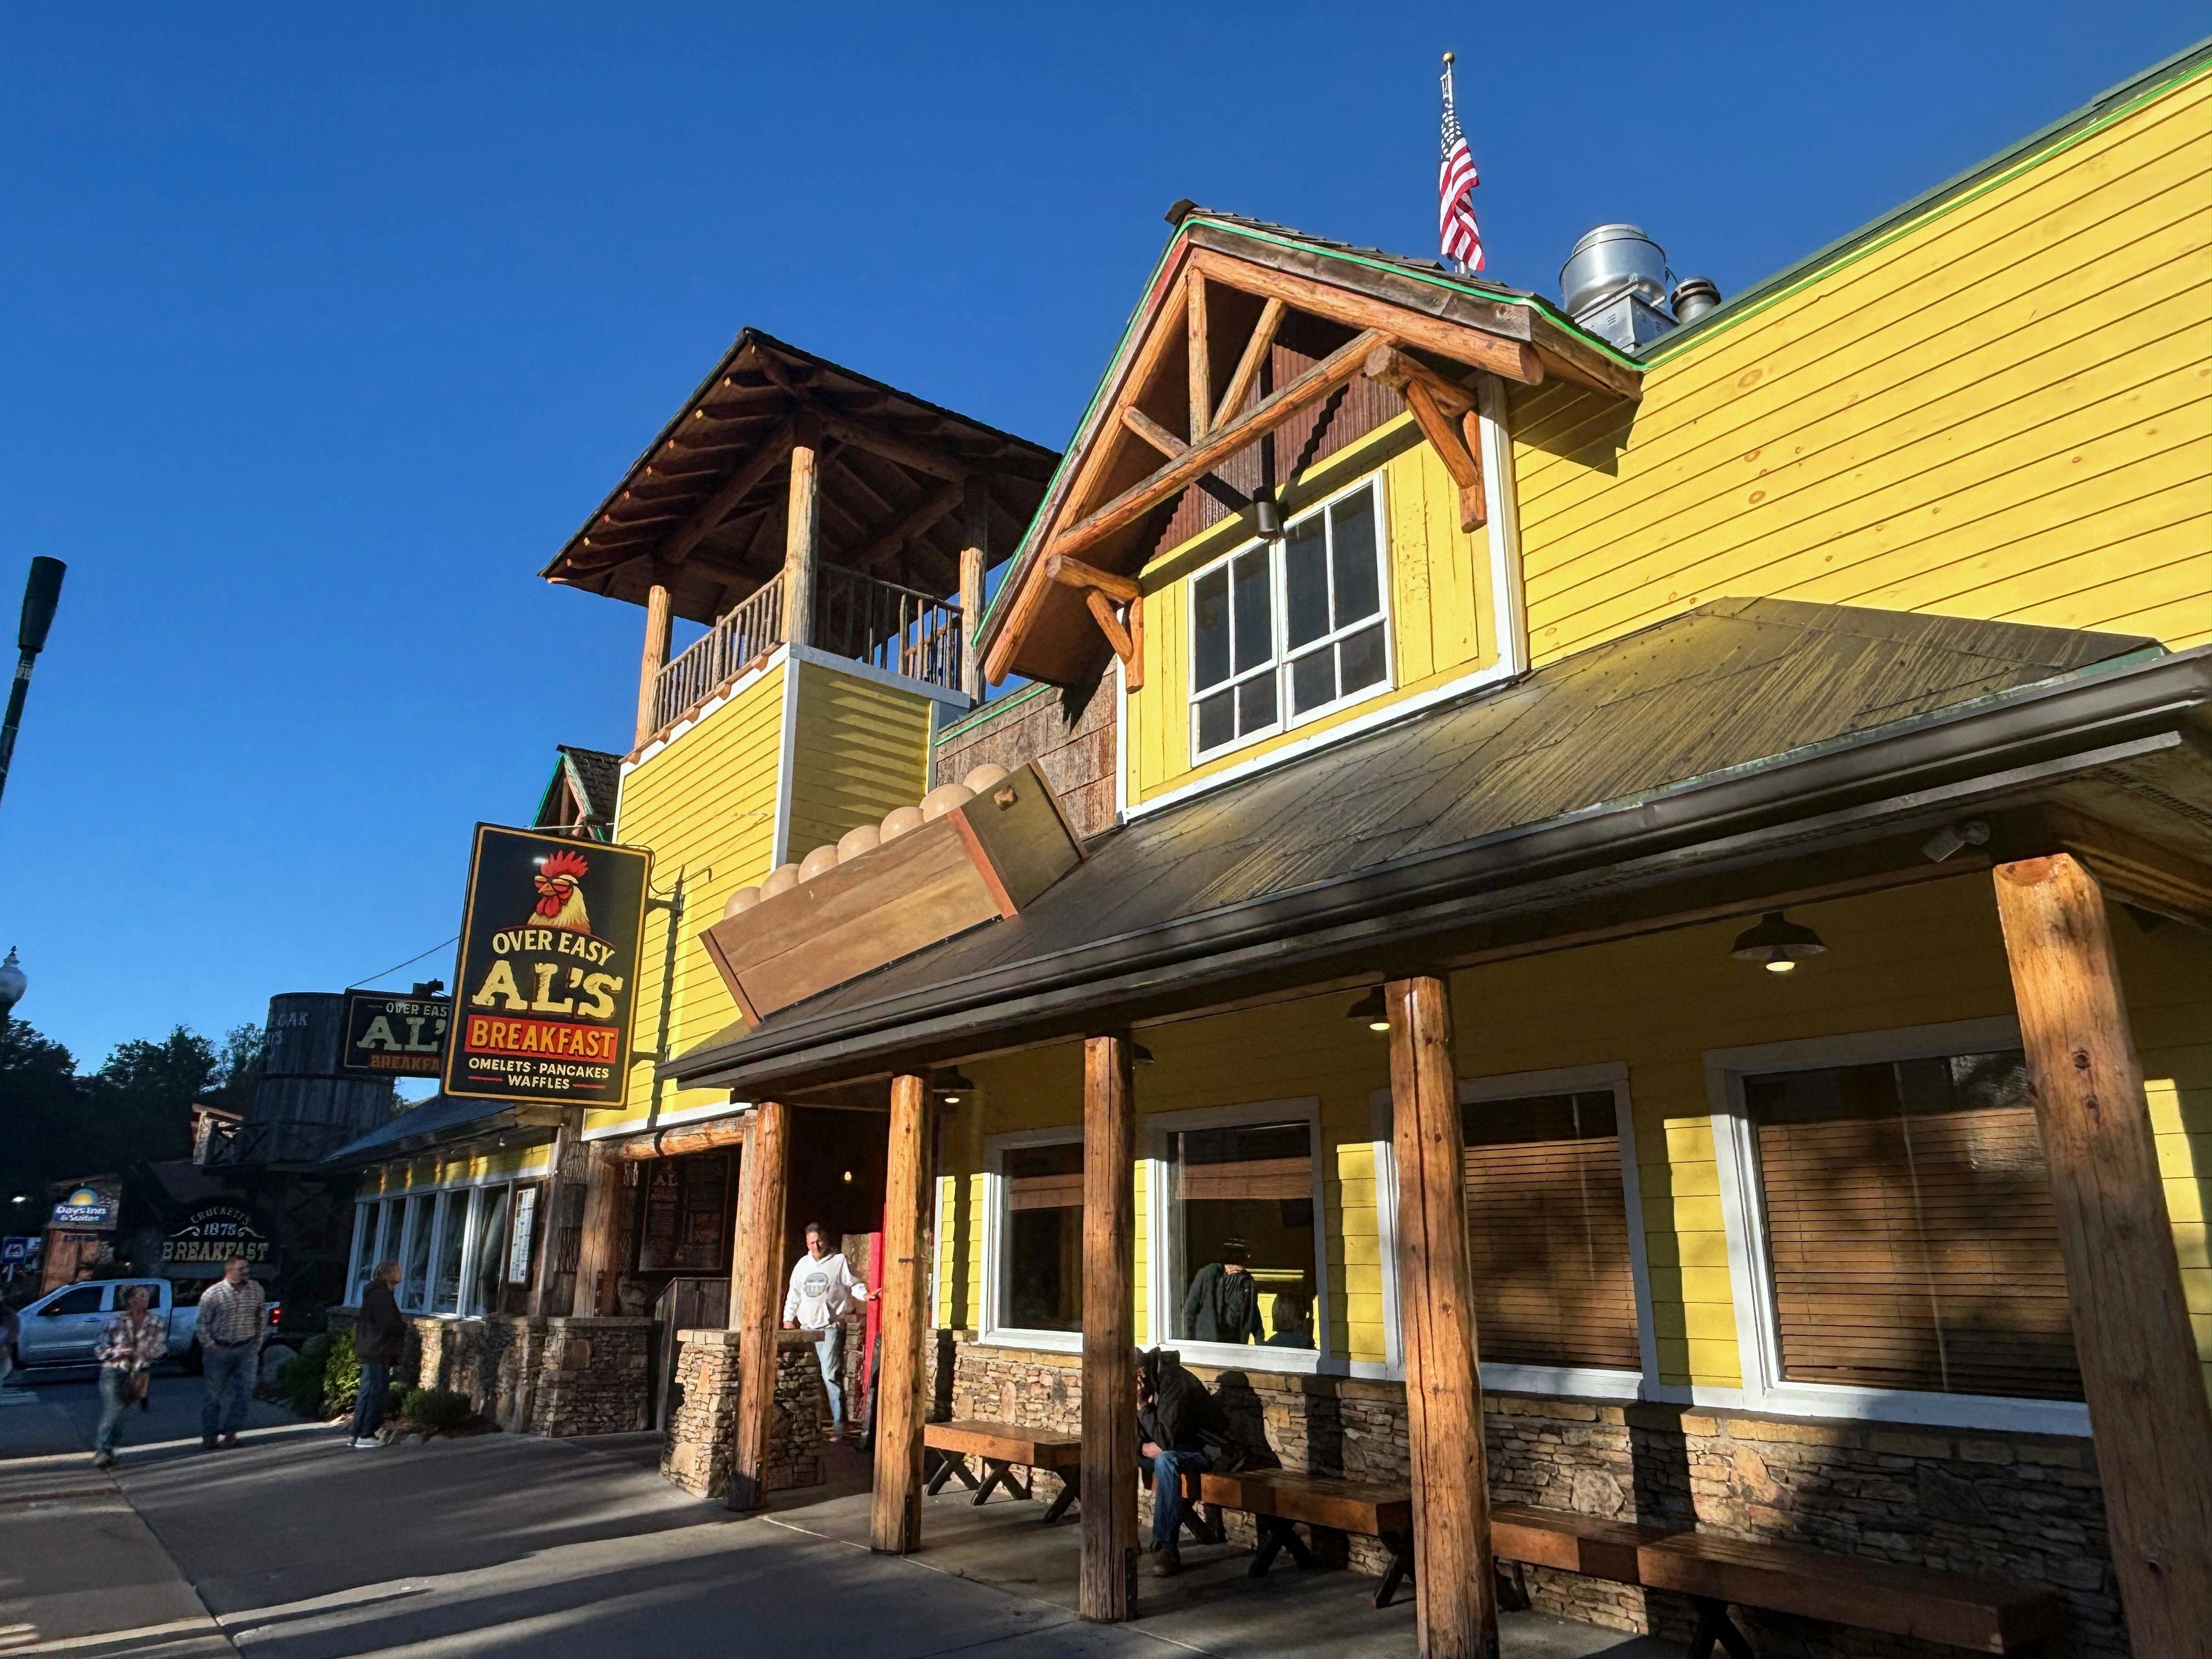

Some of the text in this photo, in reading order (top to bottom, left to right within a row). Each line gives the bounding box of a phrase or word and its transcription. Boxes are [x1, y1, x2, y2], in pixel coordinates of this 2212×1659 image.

[493, 930, 615, 967] OVER EASY
[472, 960, 623, 1019] AL'S
[386, 1002, 448, 1017] OVER EAS
[357, 1015, 446, 1052] AL'
[471, 1019, 615, 1058] BREAKFAST
[370, 1054, 441, 1071] BREAKFA
[469, 1057, 610, 1079] OMELETS PANCAKES
[508, 1074, 571, 1090] WAFFLES
[56, 1205, 86, 1215] Days
[161, 1241, 270, 1262] BREAKFAST
